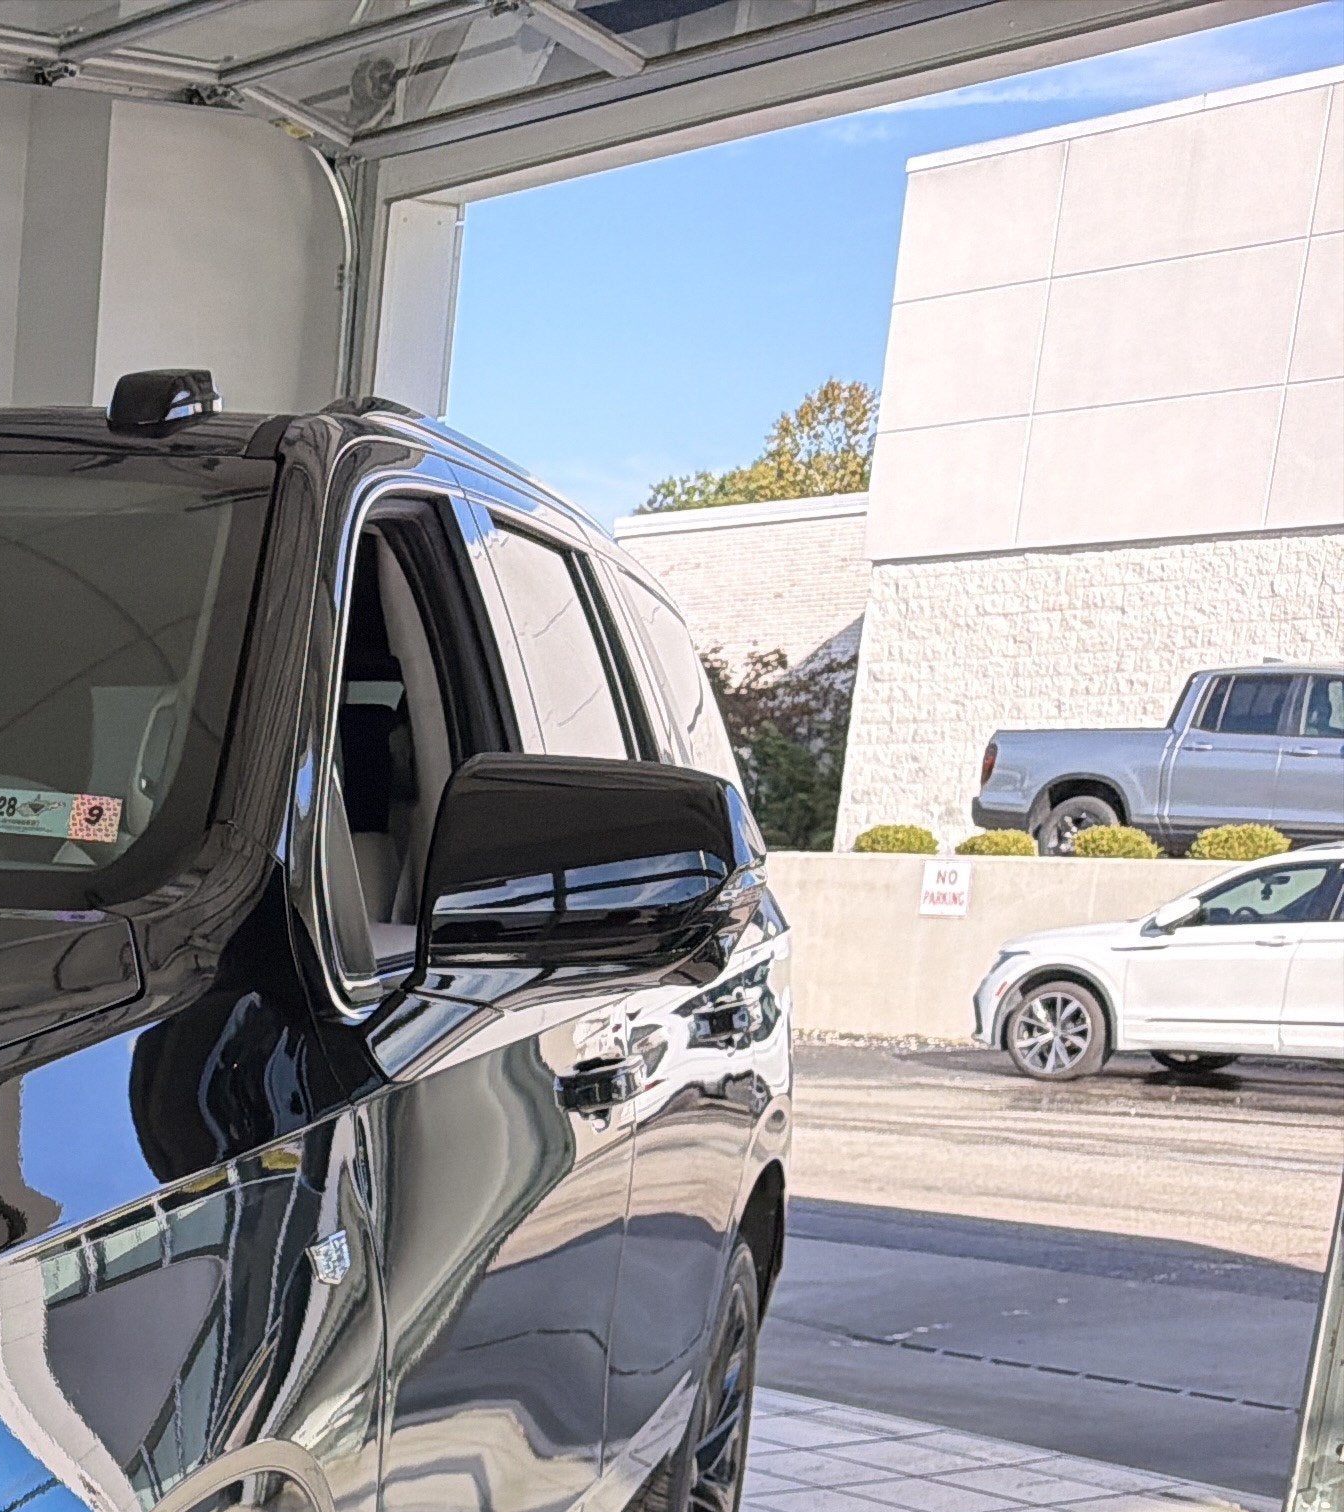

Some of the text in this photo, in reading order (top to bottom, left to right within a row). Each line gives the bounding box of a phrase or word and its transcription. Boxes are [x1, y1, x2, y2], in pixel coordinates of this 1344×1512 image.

[85, 805, 104, 826] 9
[936, 869, 958, 885] NO
[922, 890, 965, 906] PARKING
